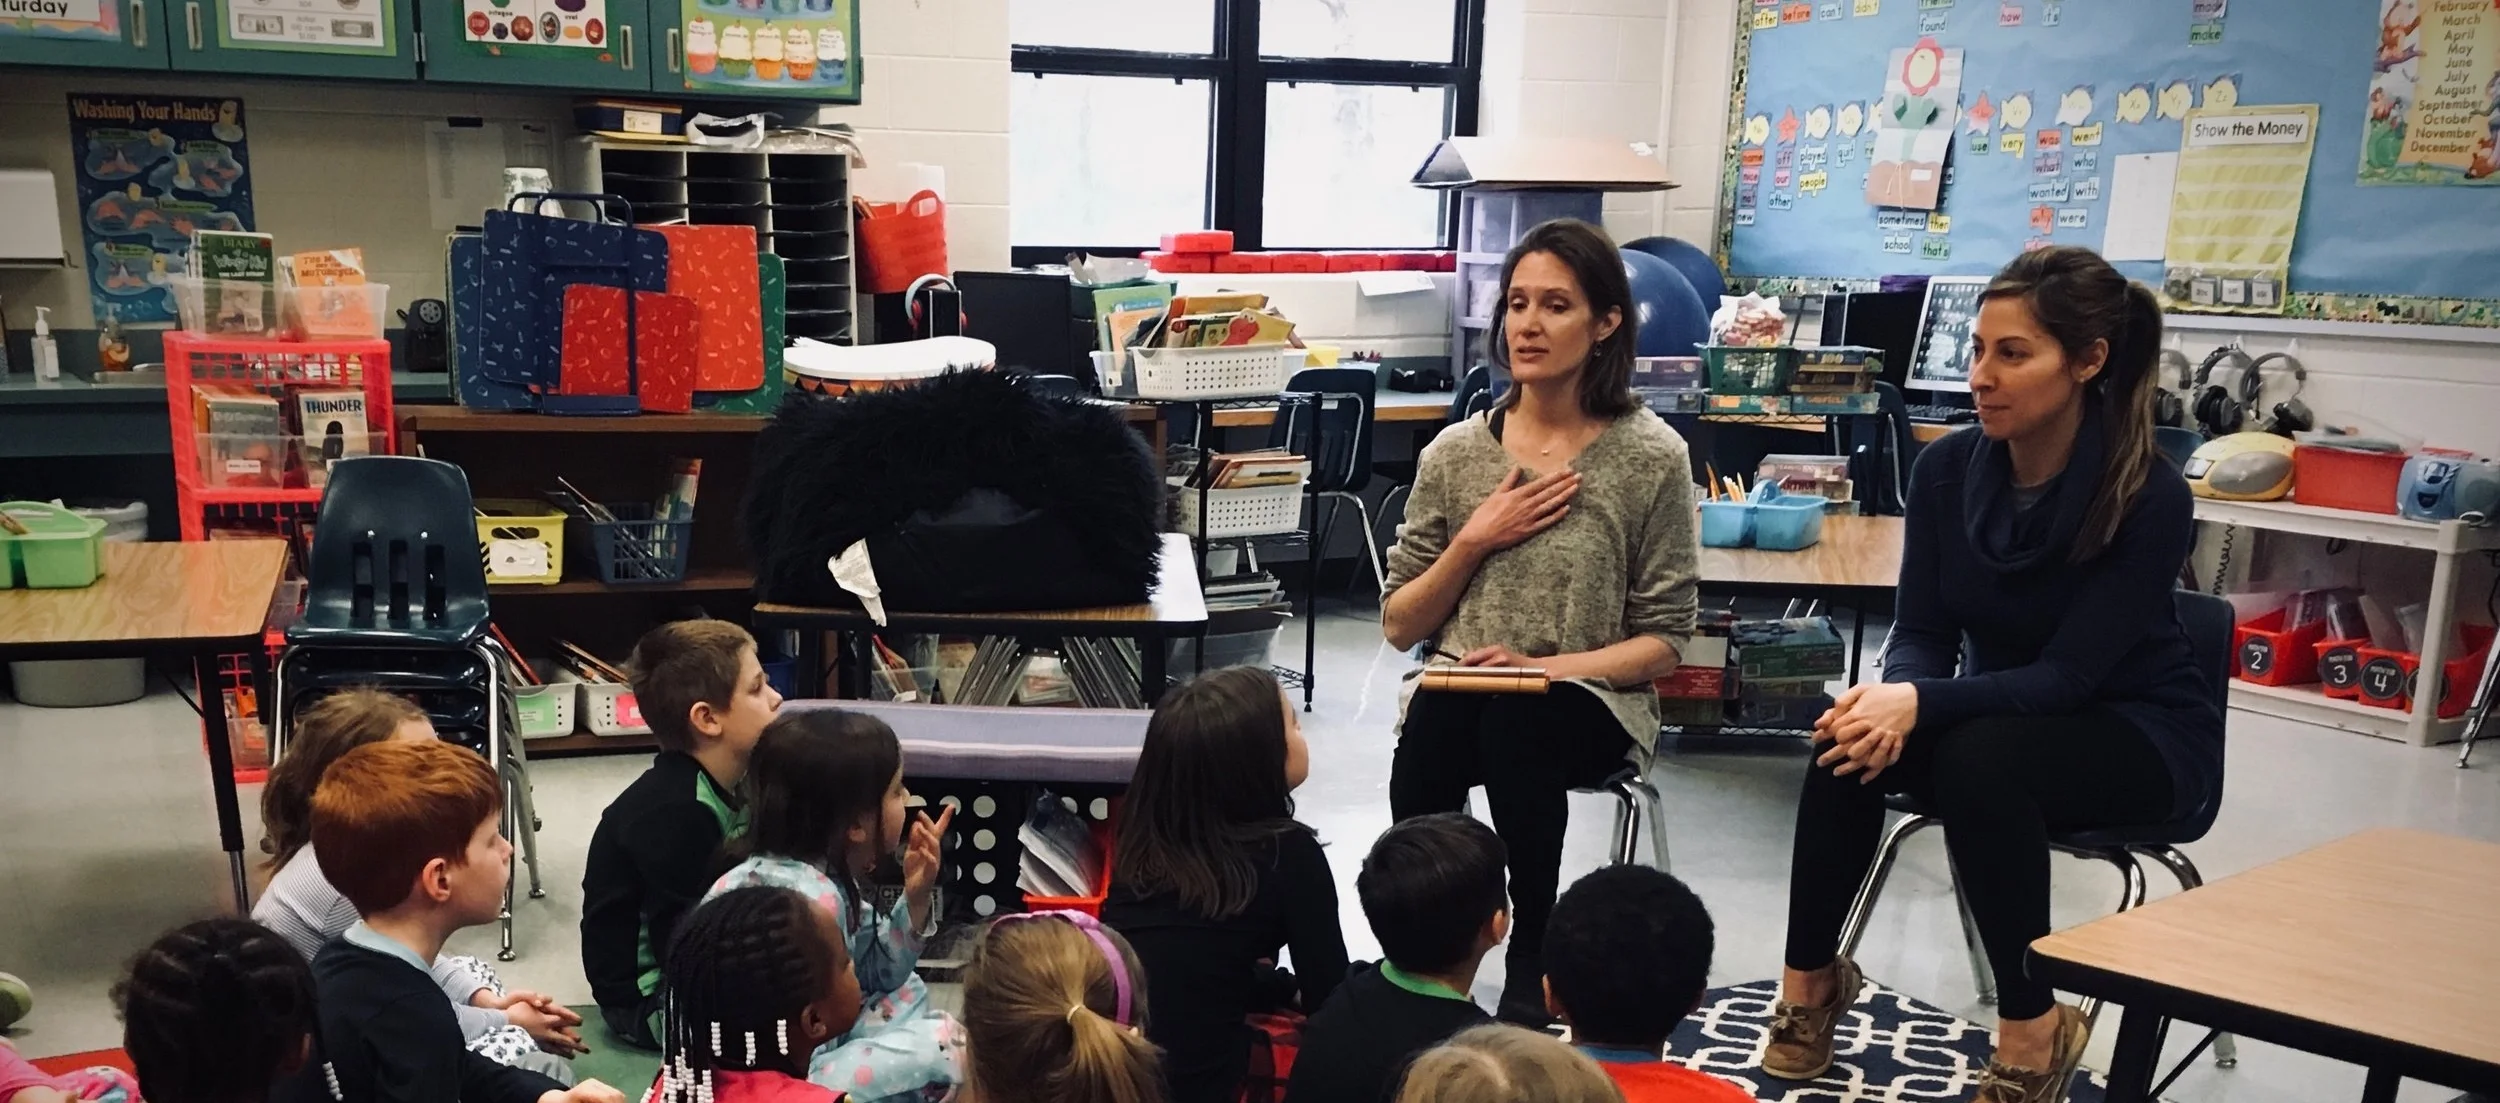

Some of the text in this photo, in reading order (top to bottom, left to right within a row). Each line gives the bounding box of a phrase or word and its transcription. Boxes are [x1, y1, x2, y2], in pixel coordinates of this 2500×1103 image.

[1755, 12, 1777, 26] after
[1782, 6, 1811, 21] before
[2000, 11, 2021, 23] how
[2442, 13, 2481, 27] March
[1919, 19, 1946, 32] found
[2191, 27, 2221, 41] make
[2443, 29, 2475, 43] April
[2447, 44, 2473, 57] May
[2445, 58, 2473, 69] June
[2444, 70, 2470, 84] July
[2434, 84, 2477, 98] August
[73, 100, 216, 124] Washing Your Hands
[2418, 100, 2484, 113] September
[2423, 113, 2473, 126] October
[2074, 130, 2100, 143] went
[2195, 121, 2304, 138] Show the Money
[2415, 127, 2478, 139] November
[1971, 142, 1988, 152] use
[2002, 139, 2024, 154] very
[2039, 136, 2061, 146] was
[2410, 141, 2471, 154] December
[1777, 150, 1793, 165] off
[1800, 149, 1828, 164] played
[2074, 153, 2094, 167] who
[2035, 157, 2060, 173] what
[1776, 175, 1789, 184] our
[1800, 175, 1825, 191] people
[2030, 184, 2067, 198] wanted
[2075, 183, 2097, 197] with
[1769, 194, 1791, 207] other
[1737, 212, 1754, 222] new
[1879, 213, 1924, 226] sometimes
[2032, 209, 2053, 227] why
[2059, 213, 2086, 224] were
[222, 237, 256, 249] DIARY
[305, 399, 362, 414] THUNDER
[2250, 651, 2263, 670] 2
[2333, 665, 2348, 684] 3
[2374, 673, 2387, 692] 4
